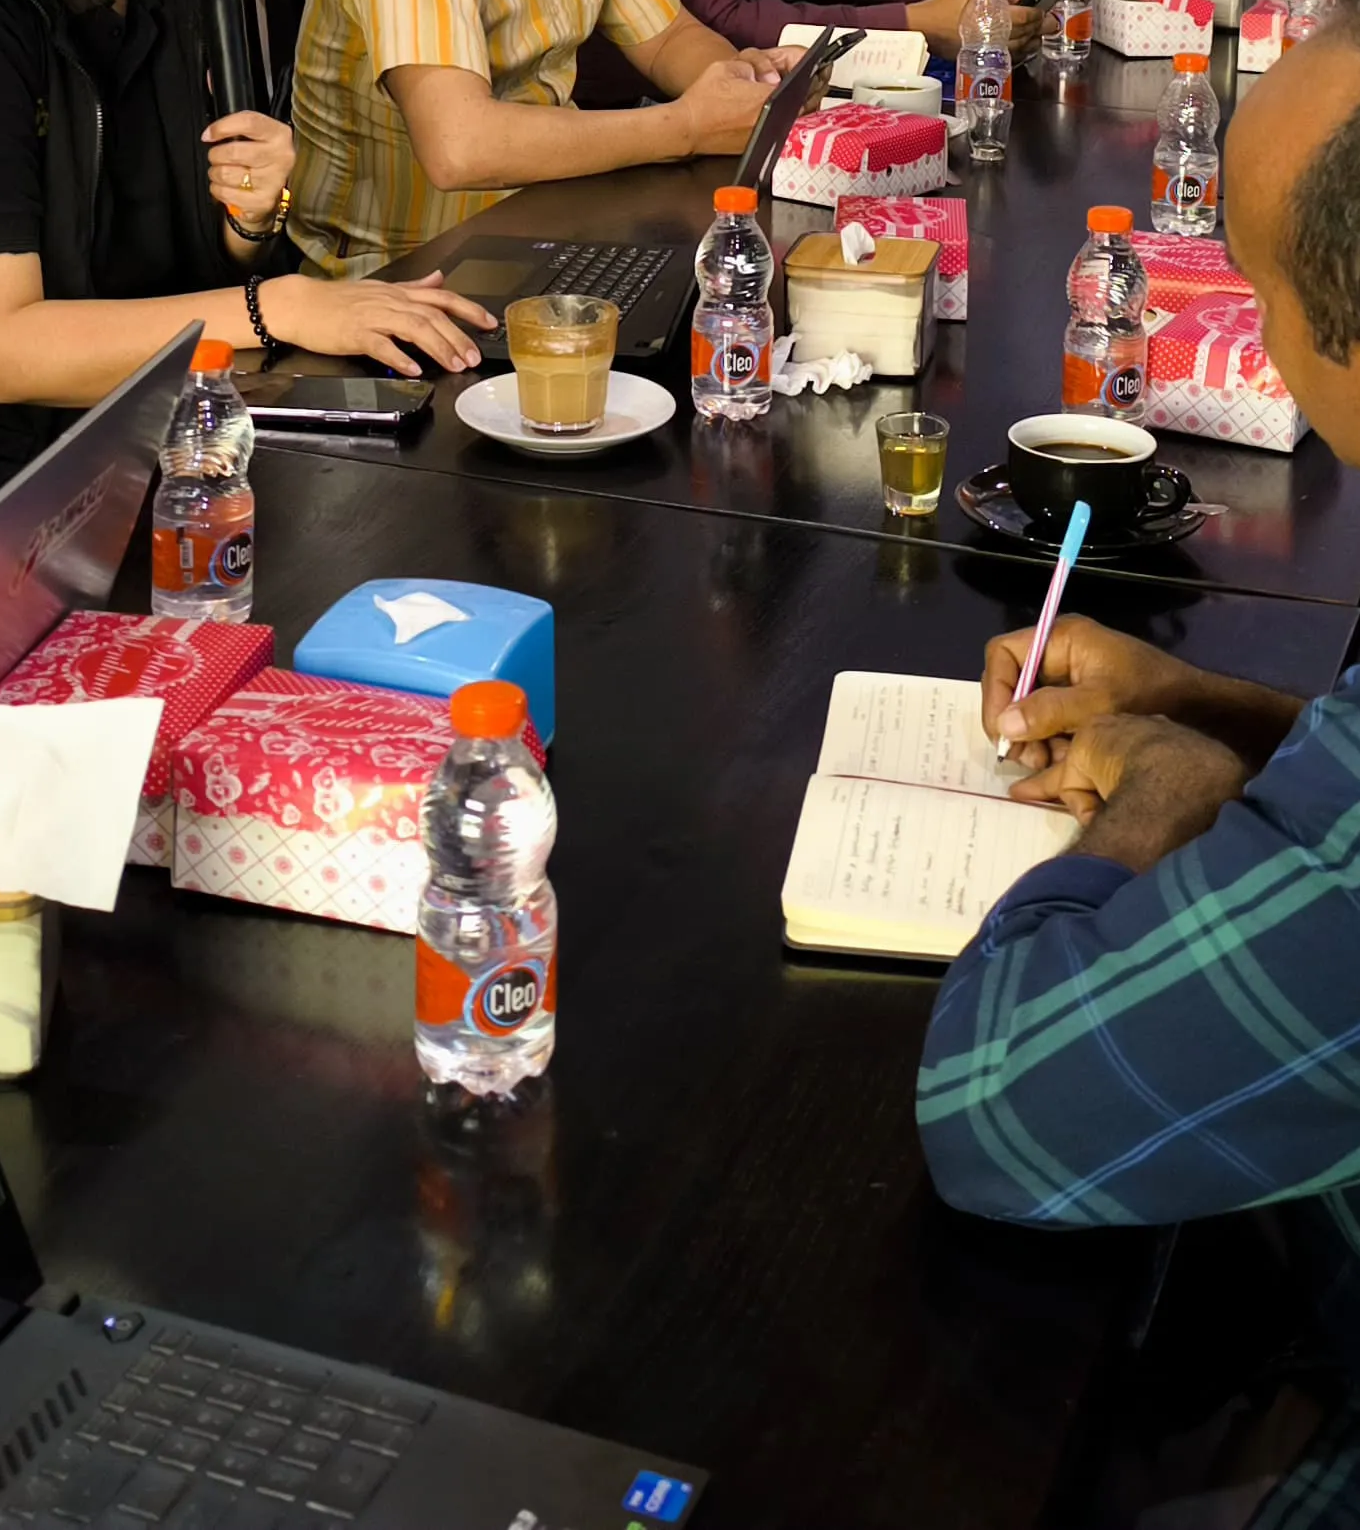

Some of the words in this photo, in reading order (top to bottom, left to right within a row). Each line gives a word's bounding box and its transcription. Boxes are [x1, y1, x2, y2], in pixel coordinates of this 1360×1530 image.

[979, 82, 999, 96] Cleo
[1176, 181, 1200, 198] Cleo
[724, 353, 753, 373] Cleo
[1116, 376, 1141, 396] Cleo
[490, 982, 536, 1016] Cleo
